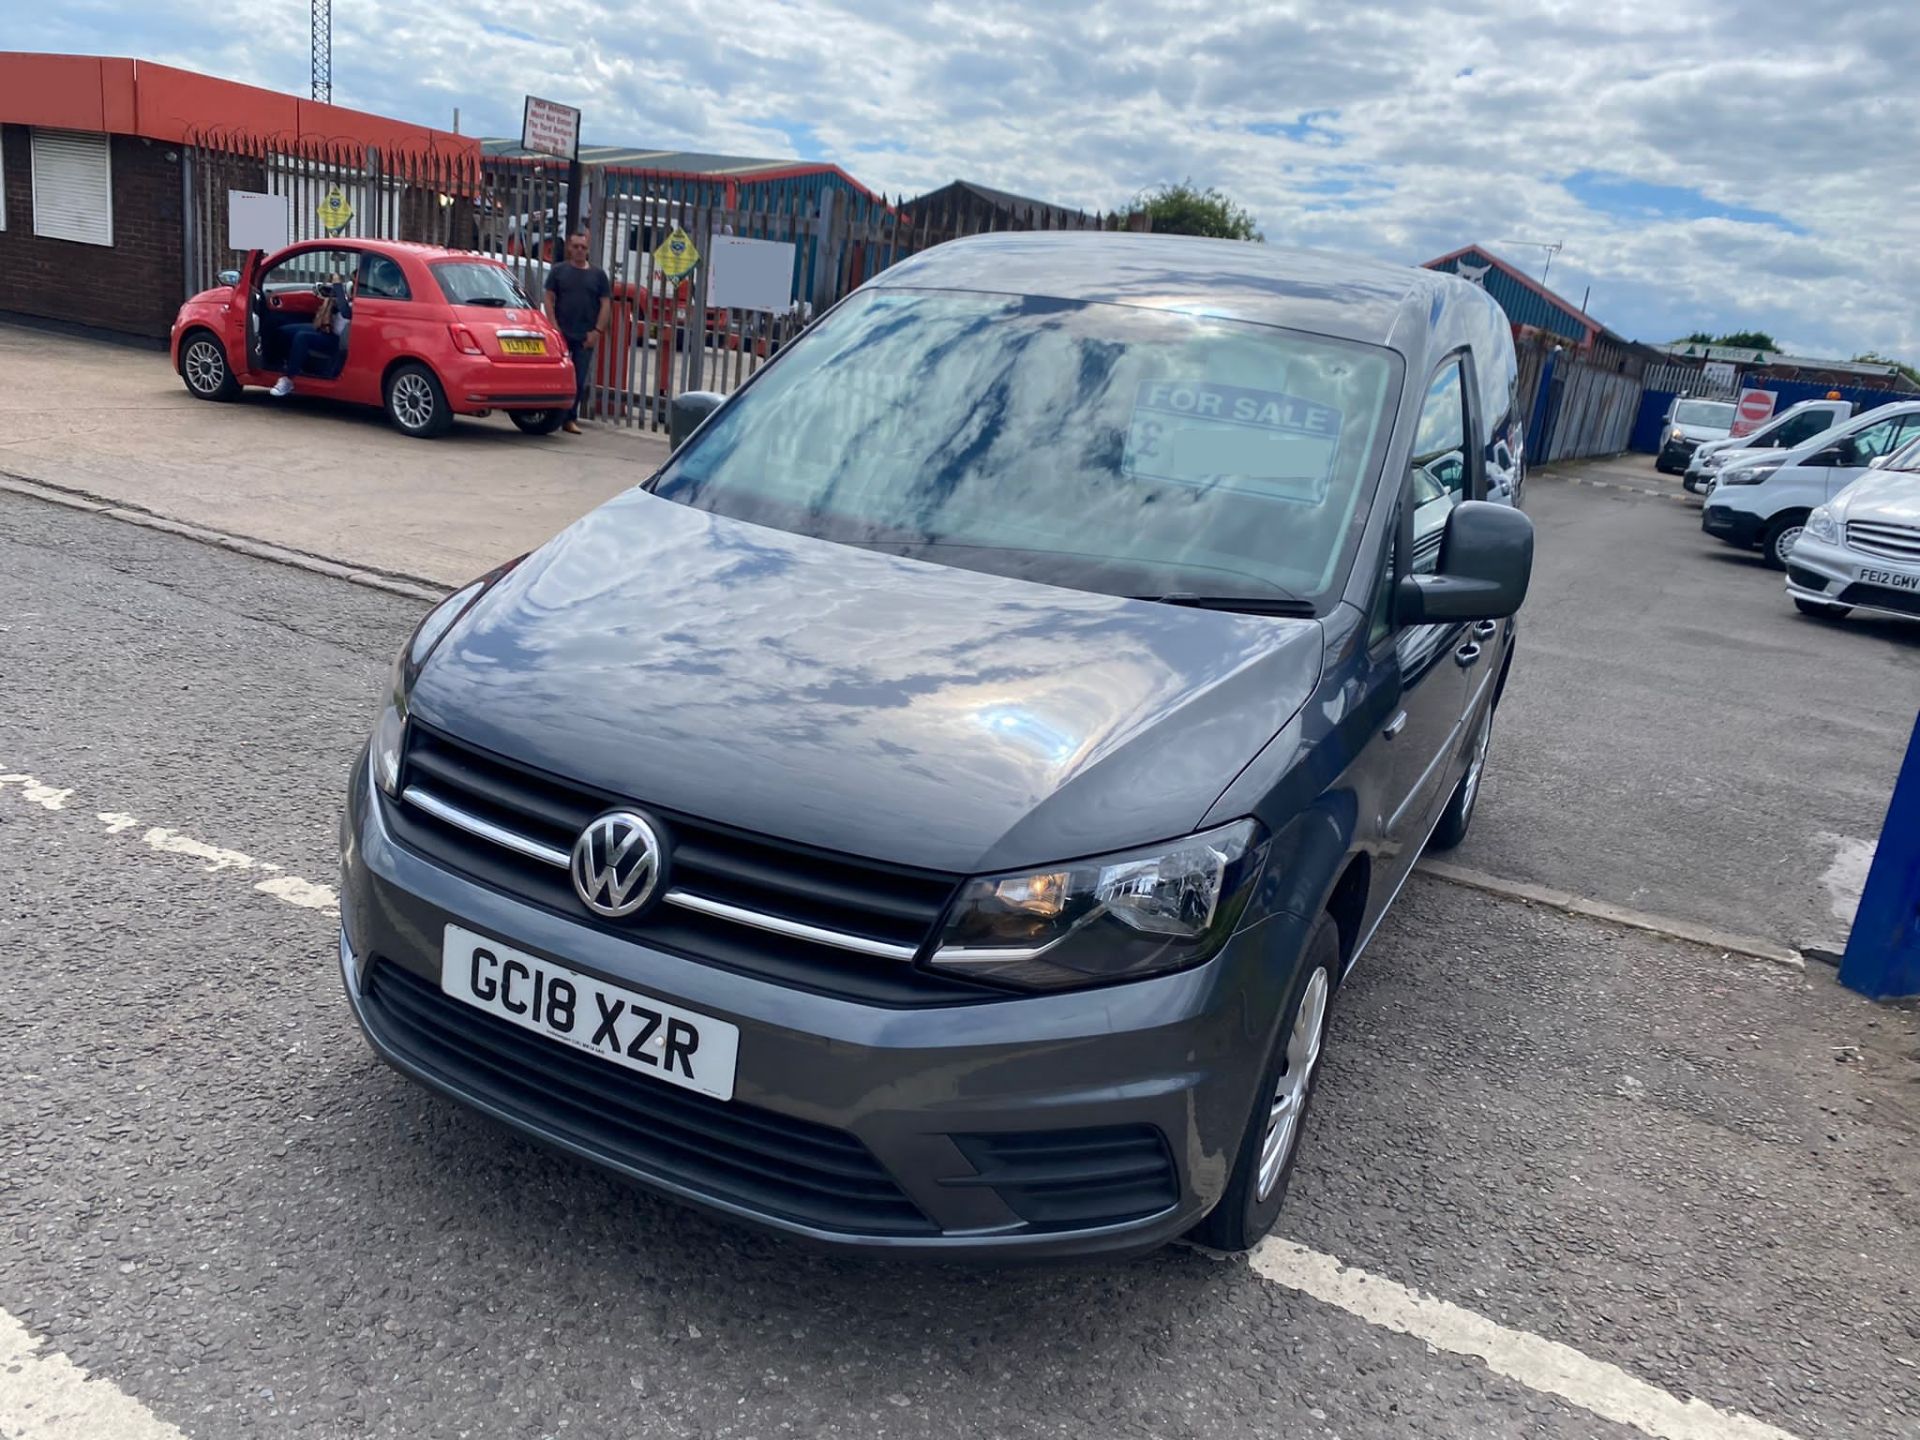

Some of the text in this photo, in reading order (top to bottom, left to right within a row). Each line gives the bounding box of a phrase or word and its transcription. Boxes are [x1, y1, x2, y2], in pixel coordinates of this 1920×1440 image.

[1148, 383, 1329, 431] FOR SALE
[1860, 568, 1890, 584] FE12
[470, 947, 700, 1079] GC18 XZR
